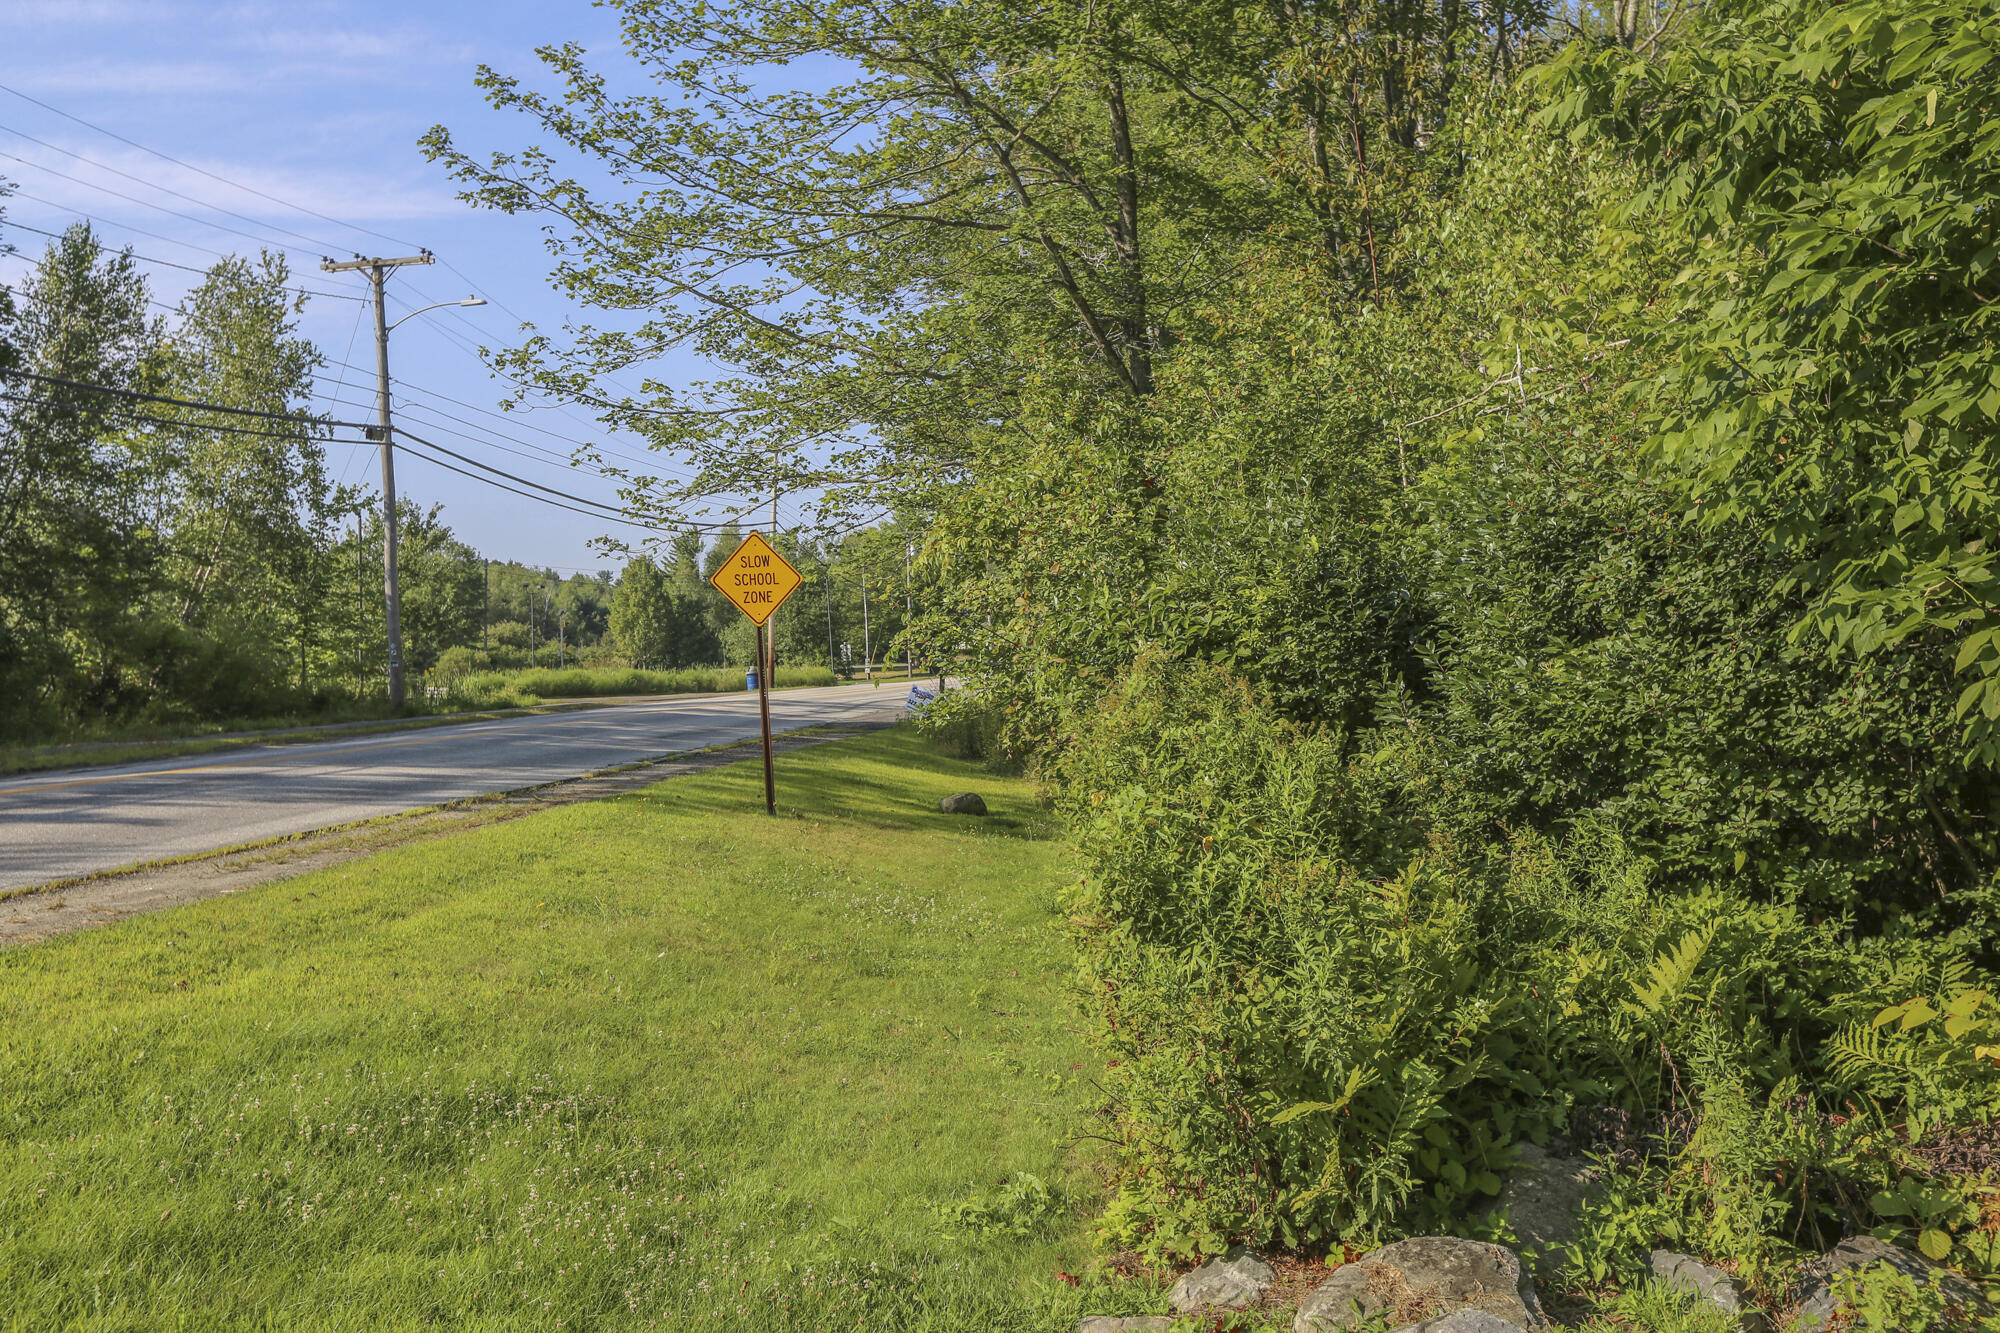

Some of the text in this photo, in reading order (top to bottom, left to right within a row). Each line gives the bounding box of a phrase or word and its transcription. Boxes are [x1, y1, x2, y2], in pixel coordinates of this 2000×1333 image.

[740, 555, 770, 568] SLOW
[734, 572, 780, 586] SCHOOL
[743, 590, 773, 603] ZONE
